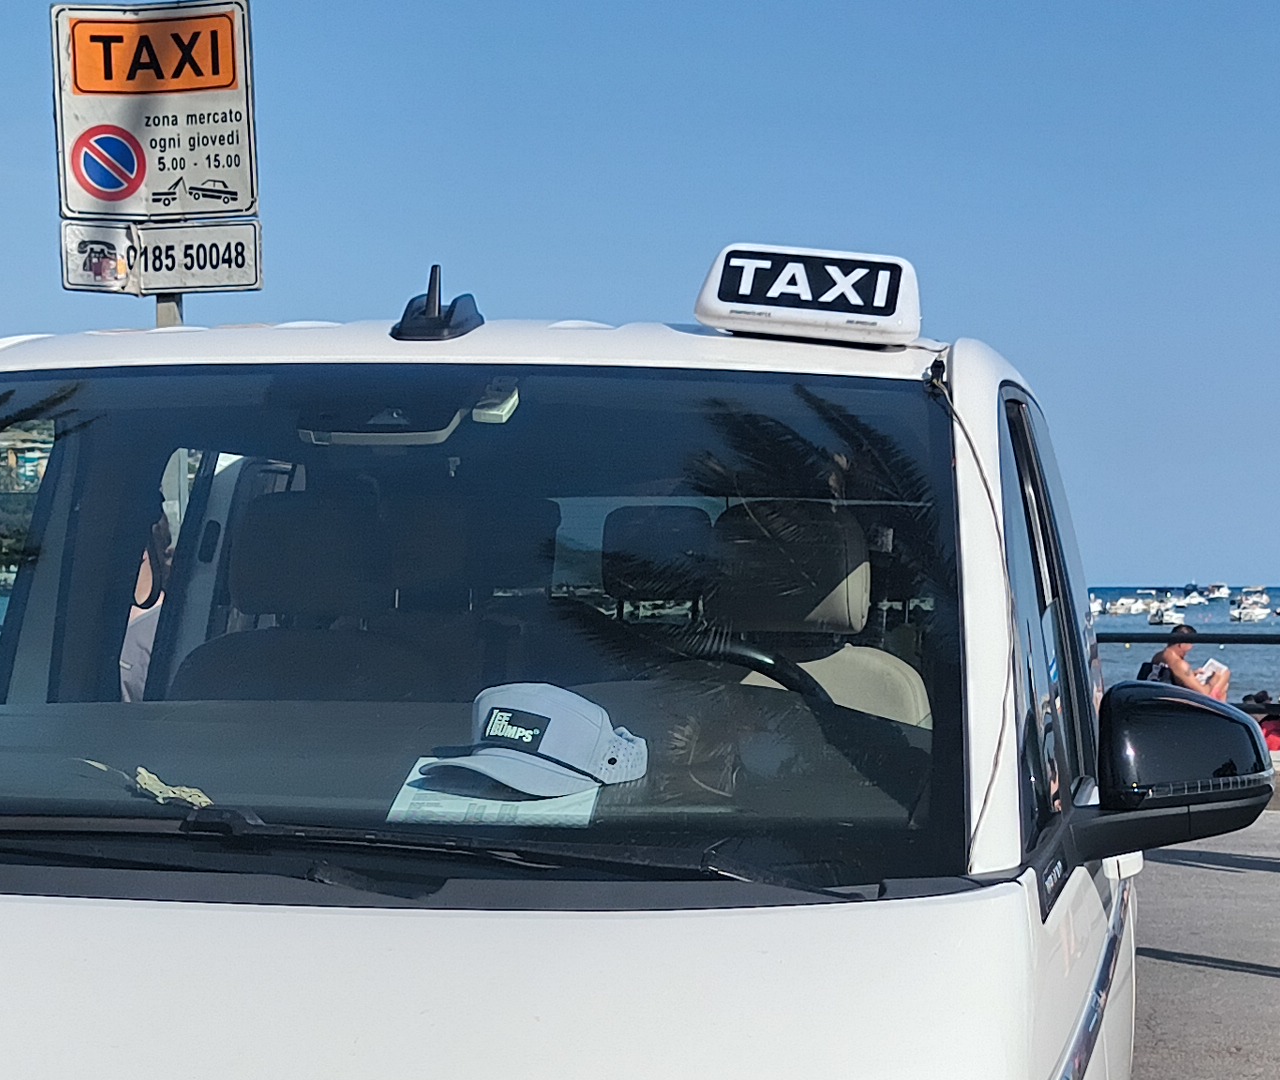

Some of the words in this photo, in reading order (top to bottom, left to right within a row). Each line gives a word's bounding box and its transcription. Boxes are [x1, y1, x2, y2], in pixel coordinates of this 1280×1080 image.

[89, 29, 221, 82] TAXI
[144, 114, 179, 127] zona
[186, 109, 243, 125] mercato
[149, 134, 181, 153] ogni
[188, 130, 240, 152] giovedi
[157, 157, 187, 172] 5.00
[205, 153, 241, 169] 15.00
[126, 245, 176, 273] 0185
[183, 241, 246, 271] 50048
[729, 257, 891, 308] TAXI
